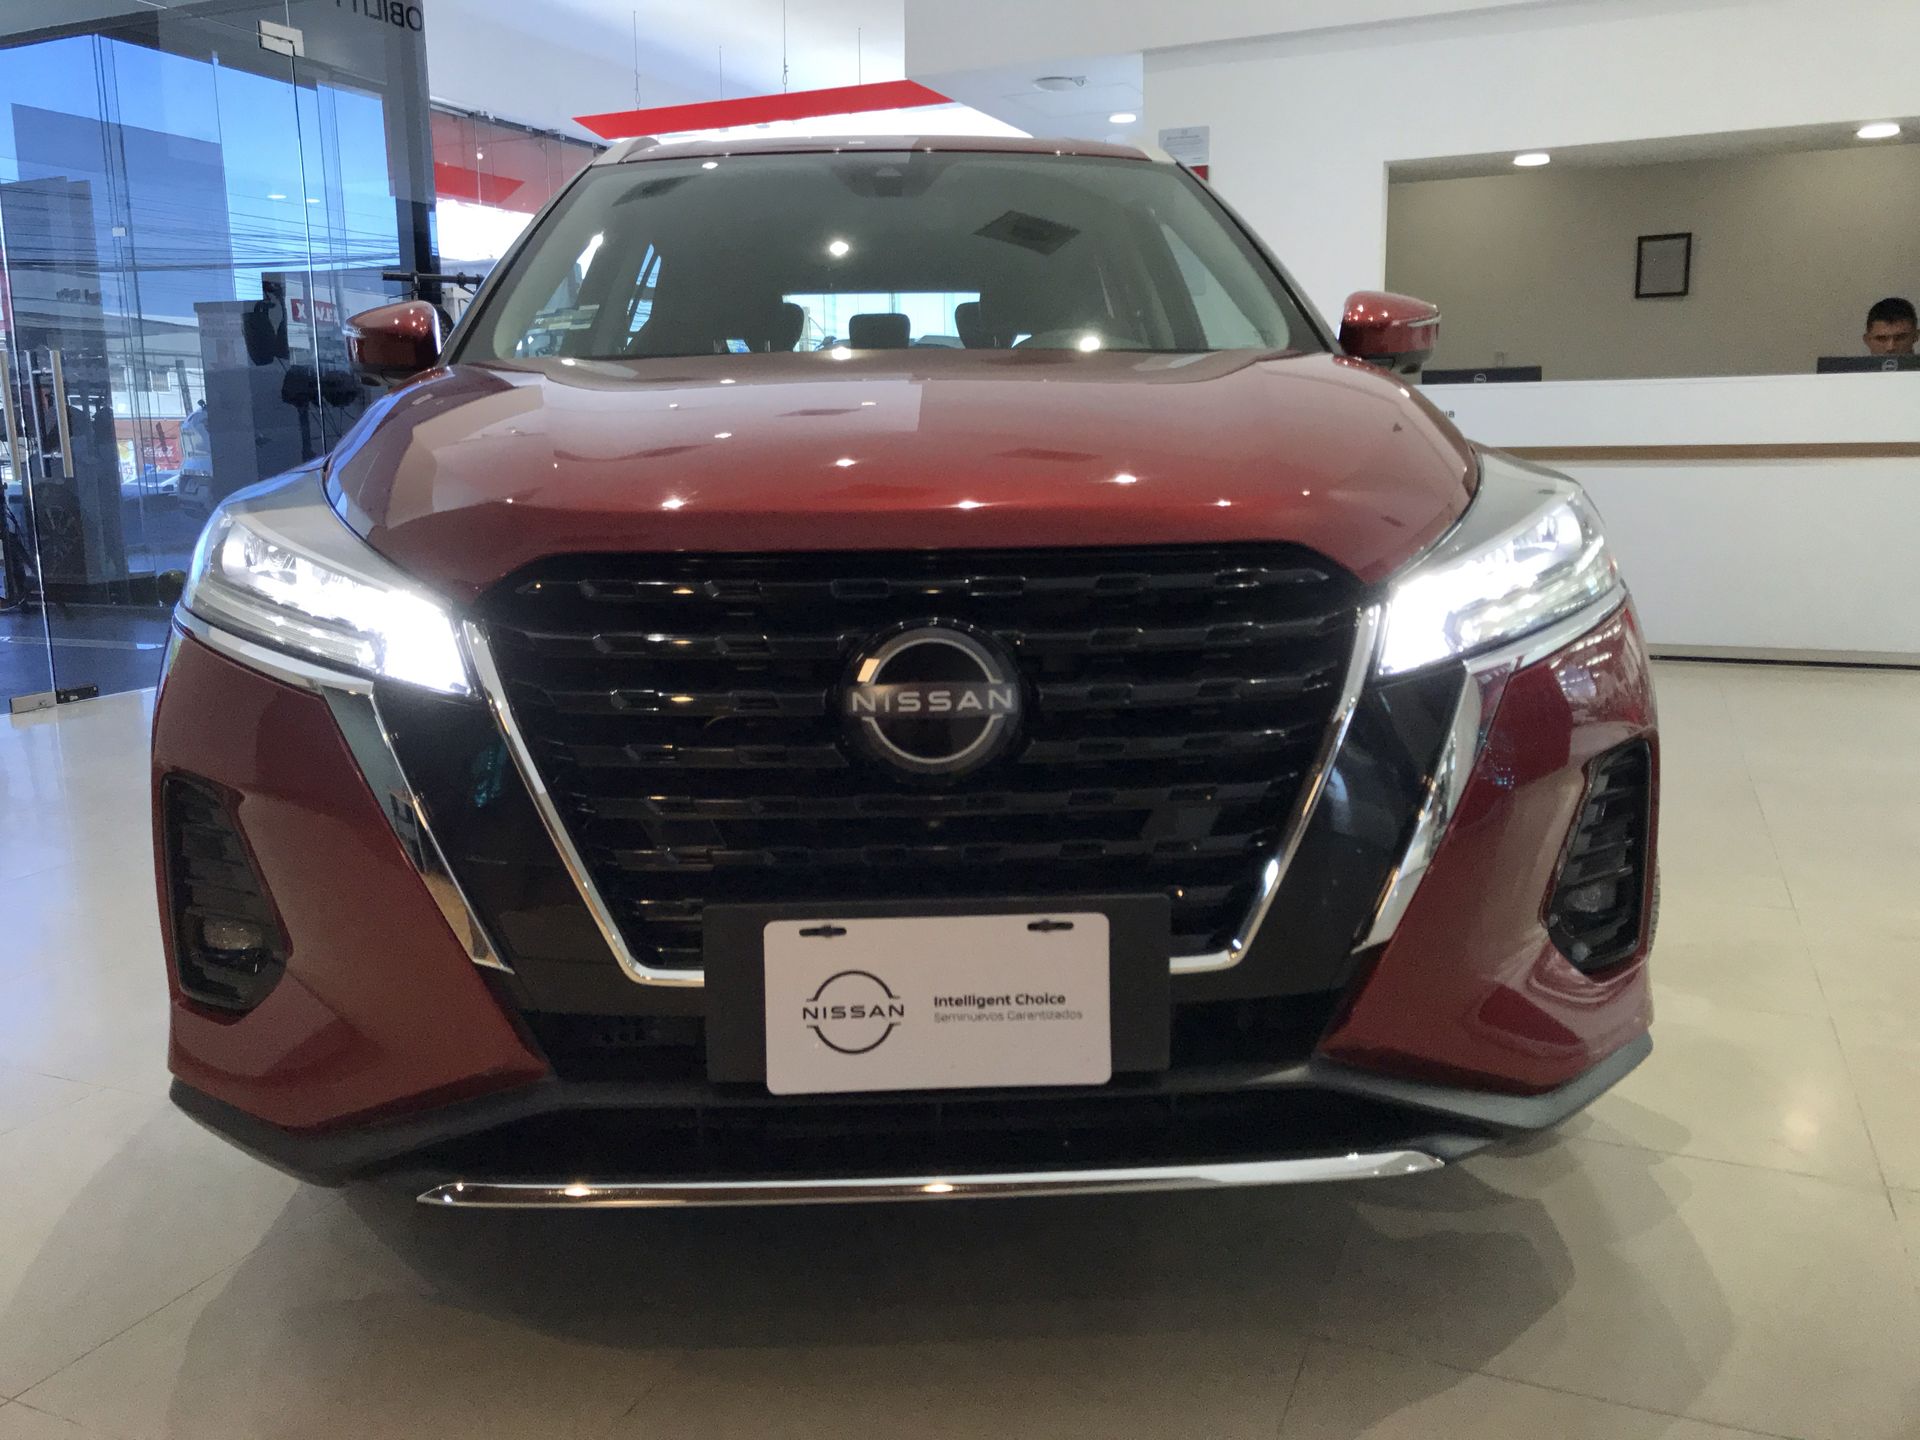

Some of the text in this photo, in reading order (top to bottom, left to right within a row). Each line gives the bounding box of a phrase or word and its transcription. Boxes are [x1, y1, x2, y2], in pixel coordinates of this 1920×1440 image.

[852, 689, 1013, 713] NISSAN
[934, 992, 1066, 1009] Intelligent Choice
[802, 1003, 904, 1020] NISSAN
[934, 1011, 1004, 1023] Seminuevos
